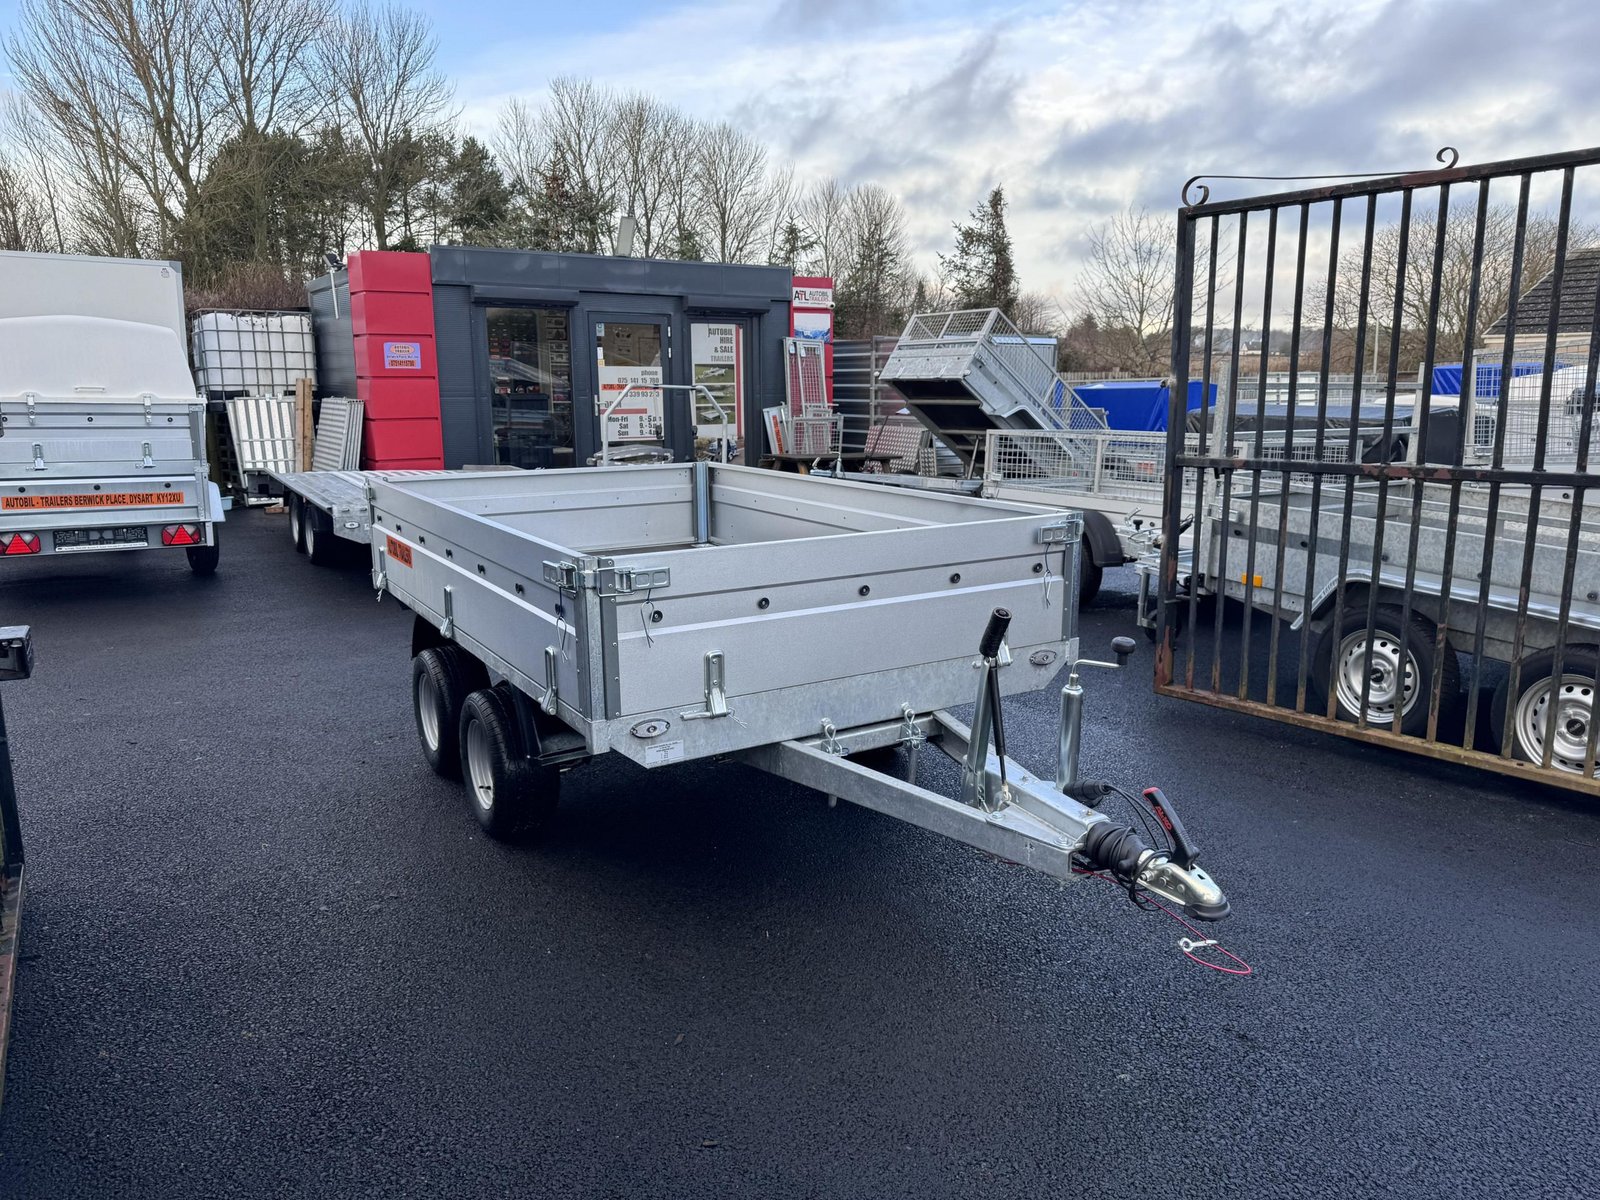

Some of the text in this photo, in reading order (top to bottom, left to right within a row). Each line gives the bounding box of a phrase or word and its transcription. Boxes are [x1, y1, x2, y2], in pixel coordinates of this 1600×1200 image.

[794, 290, 809, 301] ATL
[708, 328, 733, 336] AUTOBIL
[719, 336, 733, 344] HIRE
[719, 345, 734, 353] SALE
[5, 497, 35, 508] AUTOBIL
[40, 496, 73, 507] TRAILERS
[74, 494, 105, 506] BERWICK
